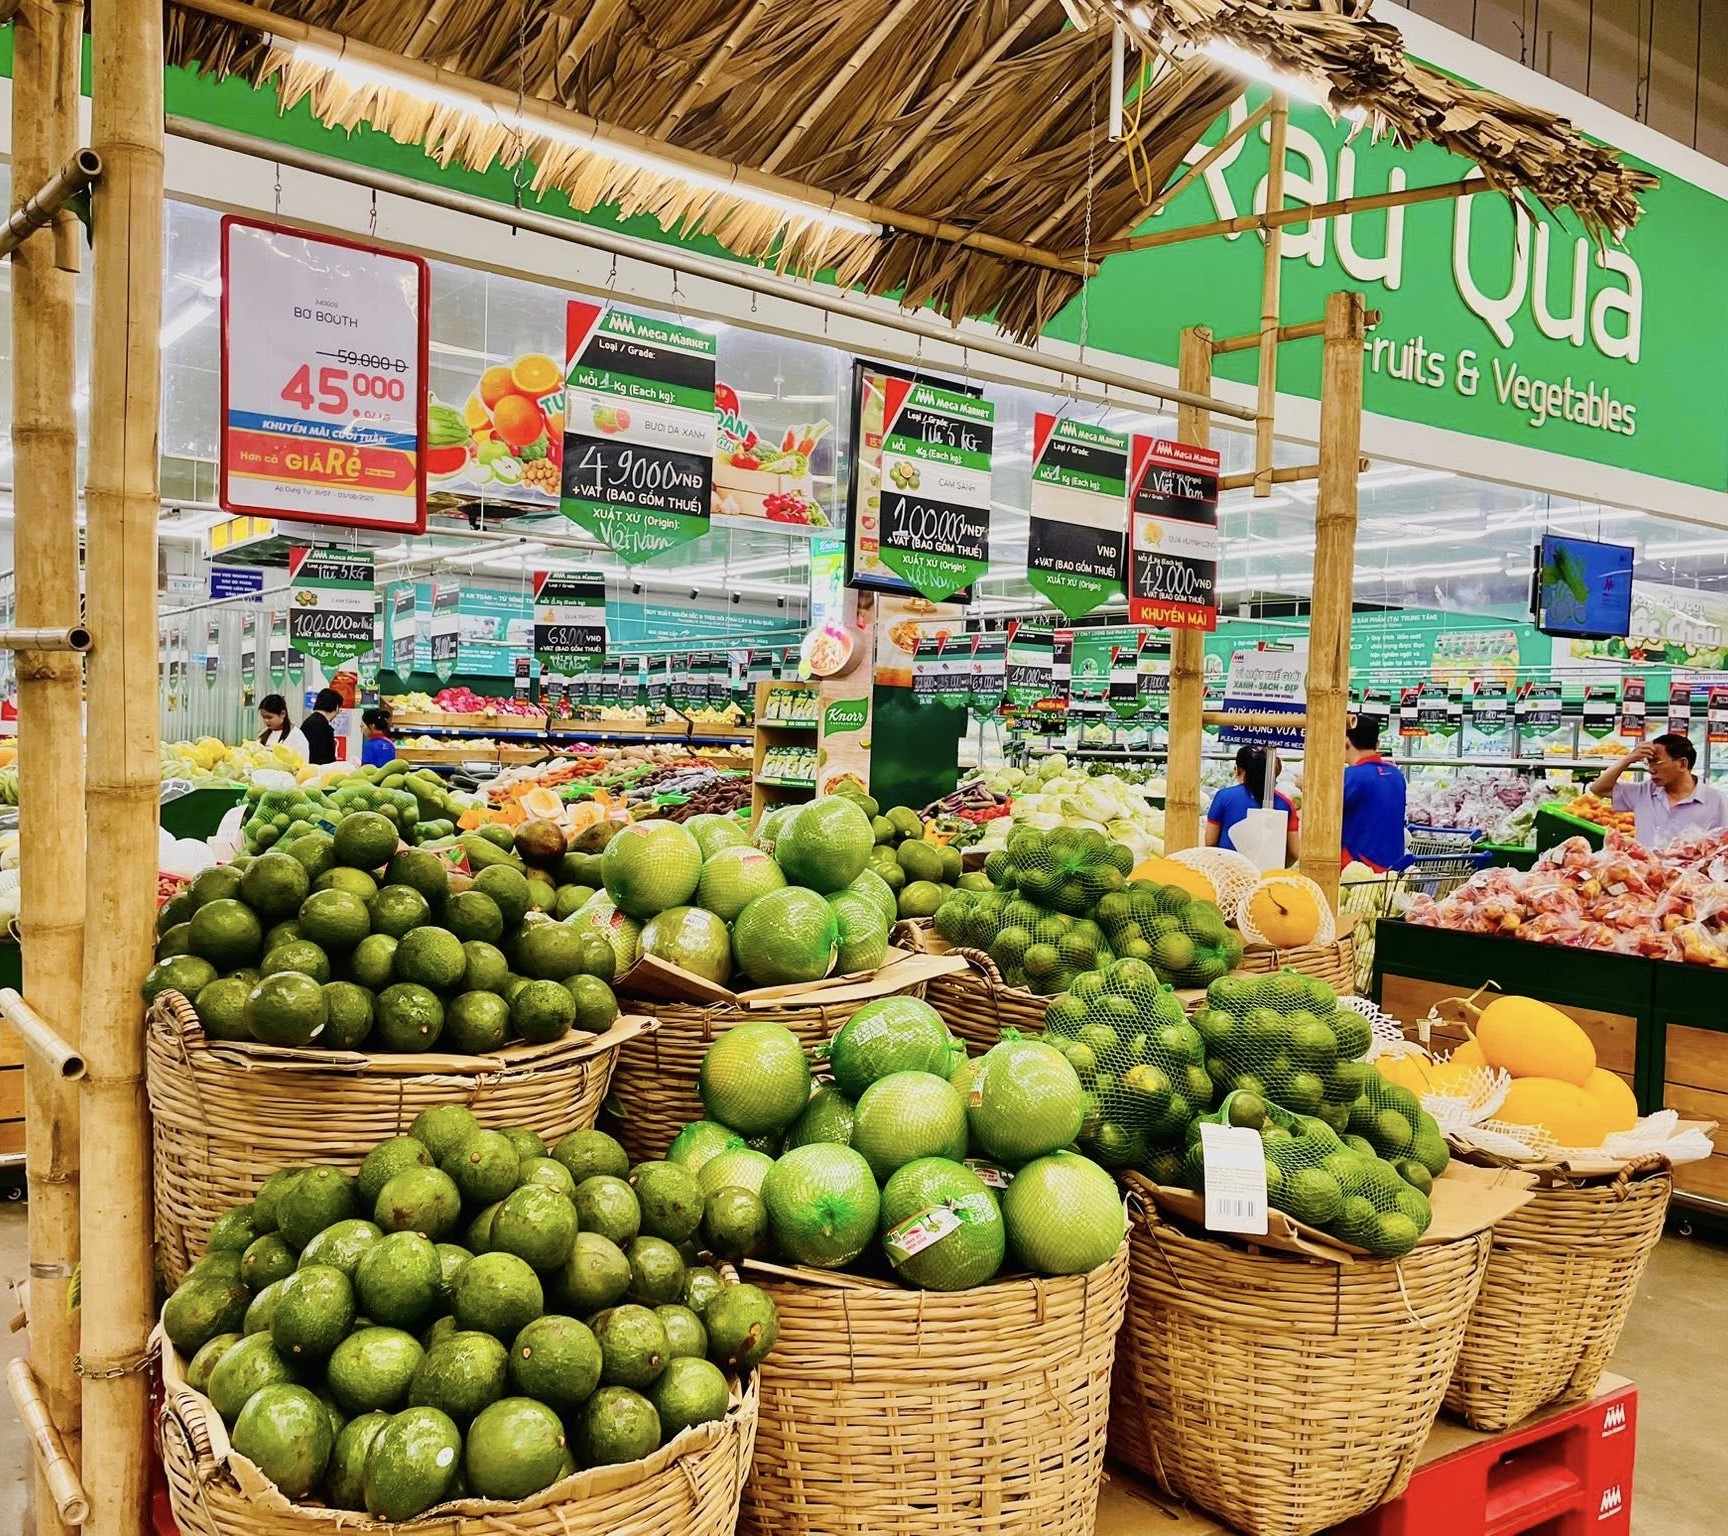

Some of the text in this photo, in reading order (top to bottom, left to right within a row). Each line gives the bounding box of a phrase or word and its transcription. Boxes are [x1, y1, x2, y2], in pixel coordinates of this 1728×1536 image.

[1153, 88, 1406, 290] Rau
[599, 339, 618, 352] Loại
[628, 346, 656, 359] Grade:
[338, 349, 390, 370] 59.000
[614, 380, 626, 395] Kg
[630, 383, 656, 398] (Each
[659, 389, 675, 404] kg):
[1364, 336, 1637, 436] ruits & Vegetables
[668, 425, 679, 434] DA
[682, 427, 706, 439] XANH
[240, 451, 261, 462] Hơn
[929, 449, 949, 461] (Each
[951, 453, 962, 465] kg):
[1071, 477, 1088, 488] (Each
[572, 484, 602, 498] +VAT
[607, 489, 635, 503] (BAO
[668, 496, 702, 514] THUẾ)
[644, 515, 680, 530] (Origin):
[1097, 545, 1116, 558] VNĐ
[940, 561, 966, 573] (Origin):
[1055, 560, 1074, 571] (BAO
[1079, 580, 1102, 592] (Origin):
[1140, 564, 1194, 594] 42.000
[1141, 605, 1184, 624] KHUYẾN
[1233, 682, 1253, 690] XANH
[1258, 682, 1278, 693] SẠCH
[827, 708, 865, 722] Knorr
[1268, 740, 1284, 748] WHAT
